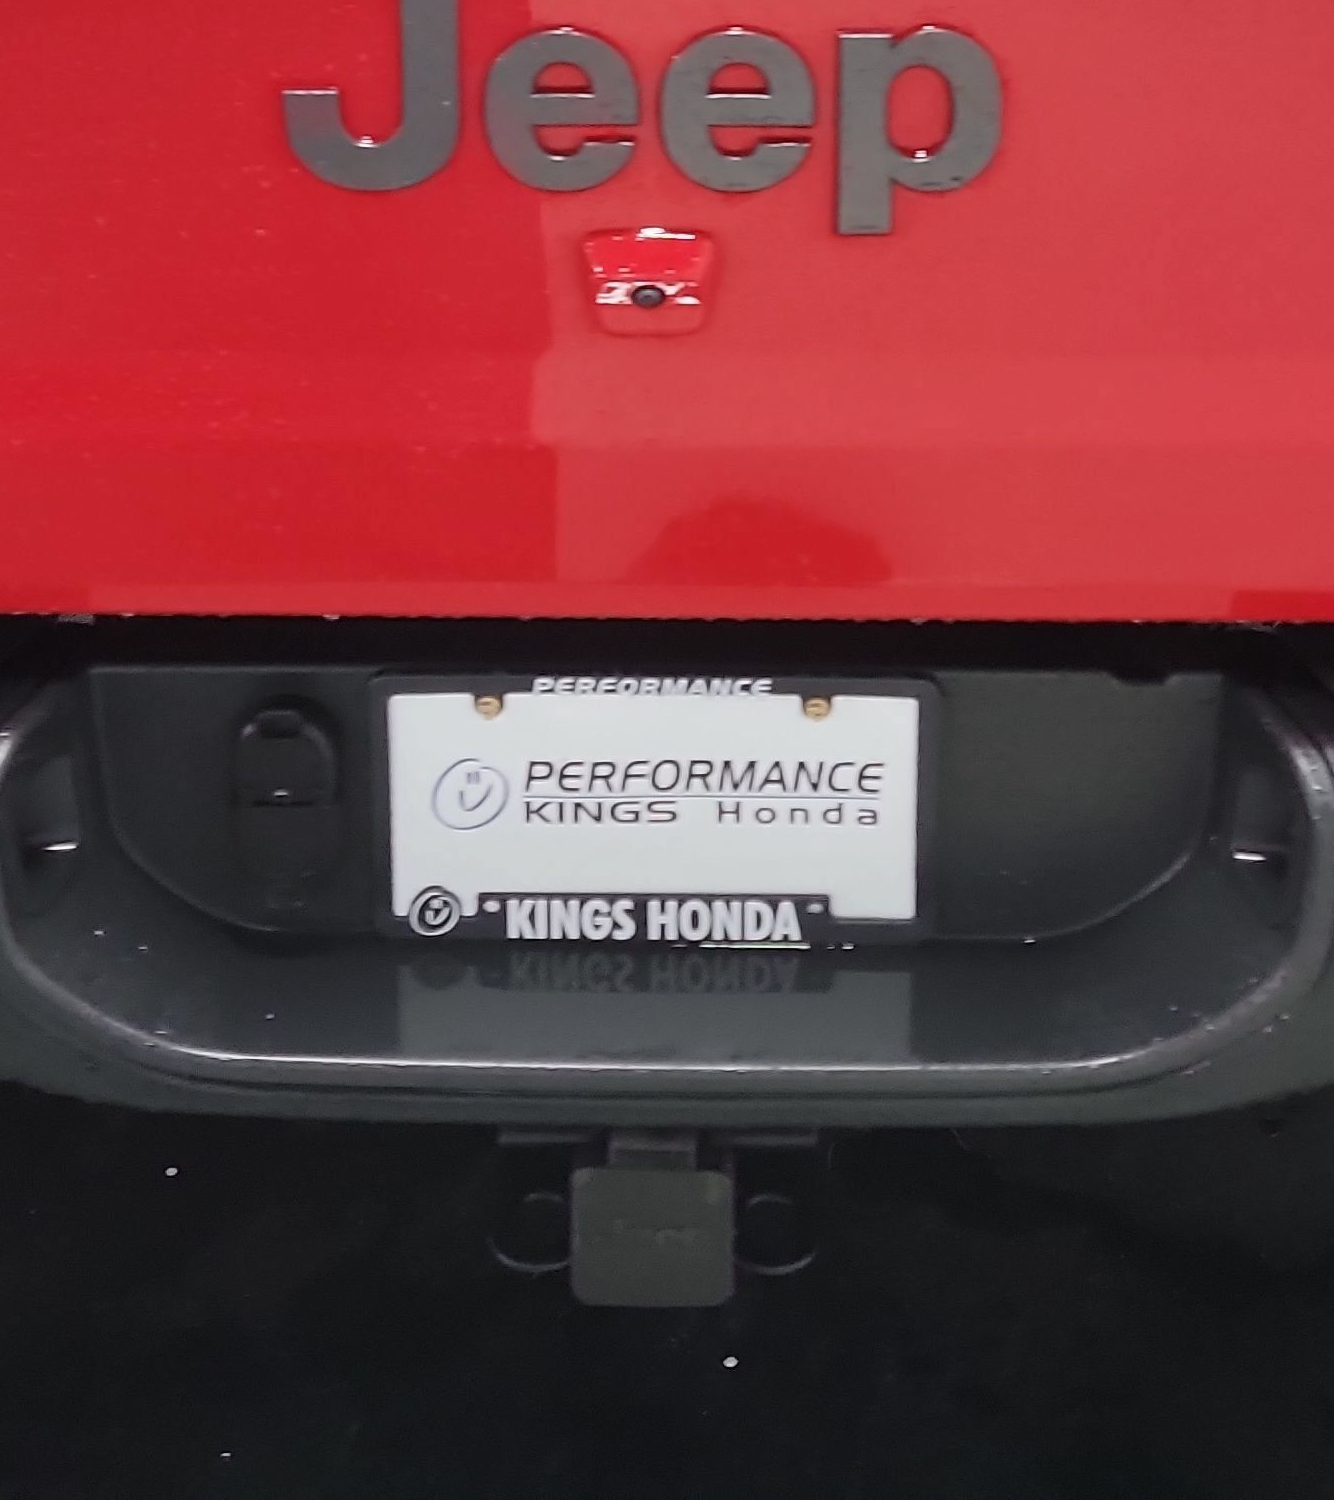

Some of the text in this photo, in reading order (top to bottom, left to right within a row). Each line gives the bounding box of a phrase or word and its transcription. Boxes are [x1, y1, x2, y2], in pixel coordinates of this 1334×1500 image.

[532, 677, 772, 695] PERFORMANCE
[526, 760, 886, 793] PERFORMANCE
[525, 800, 880, 826] KINGS Honda
[506, 900, 801, 941] KINGS HONDA
